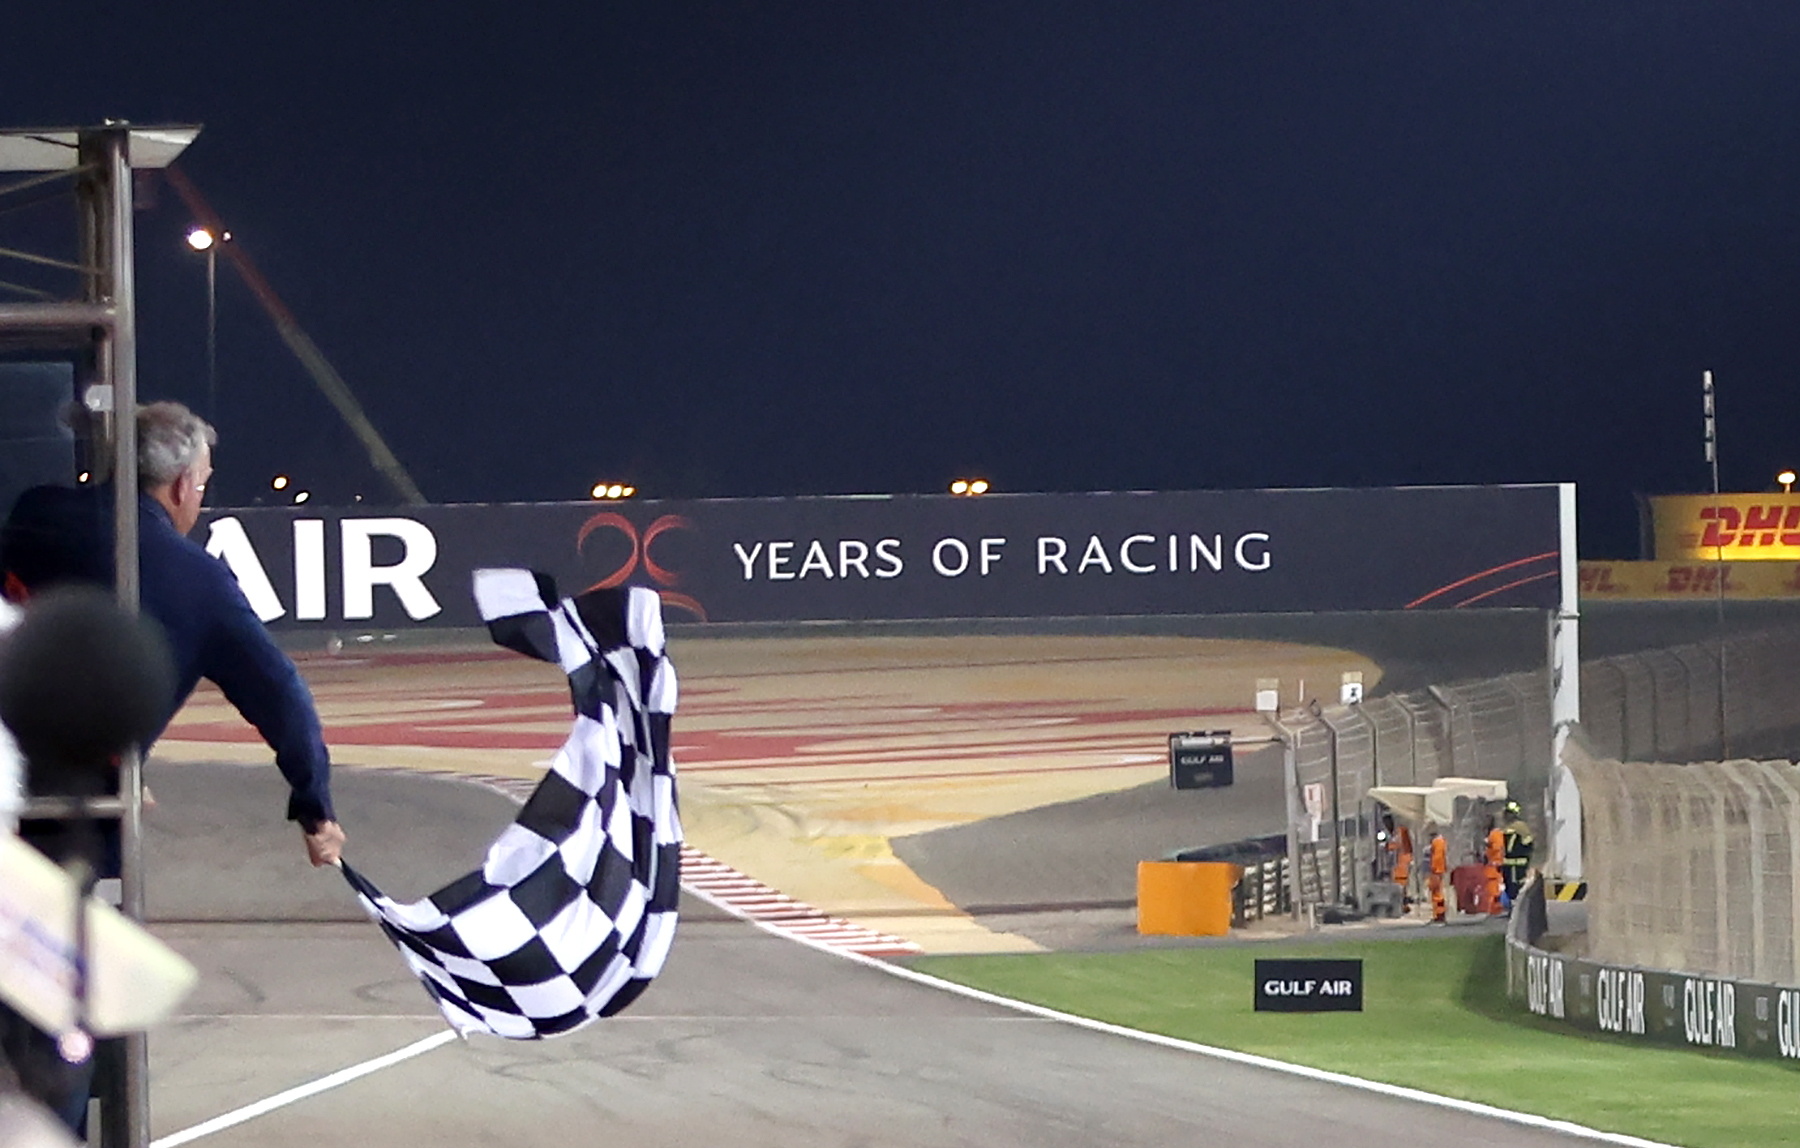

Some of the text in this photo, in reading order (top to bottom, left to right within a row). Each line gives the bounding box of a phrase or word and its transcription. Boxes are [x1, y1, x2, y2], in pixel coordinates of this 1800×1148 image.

[733, 539, 903, 580] YEARS
[932, 538, 1006, 577] OF
[1038, 533, 1271, 574] RACING
[1264, 980, 1352, 995] GULF AIR
[1597, 968, 1625, 1032] GULF
[1684, 978, 1714, 1046] GULF
[1715, 980, 1736, 1048] AIR
